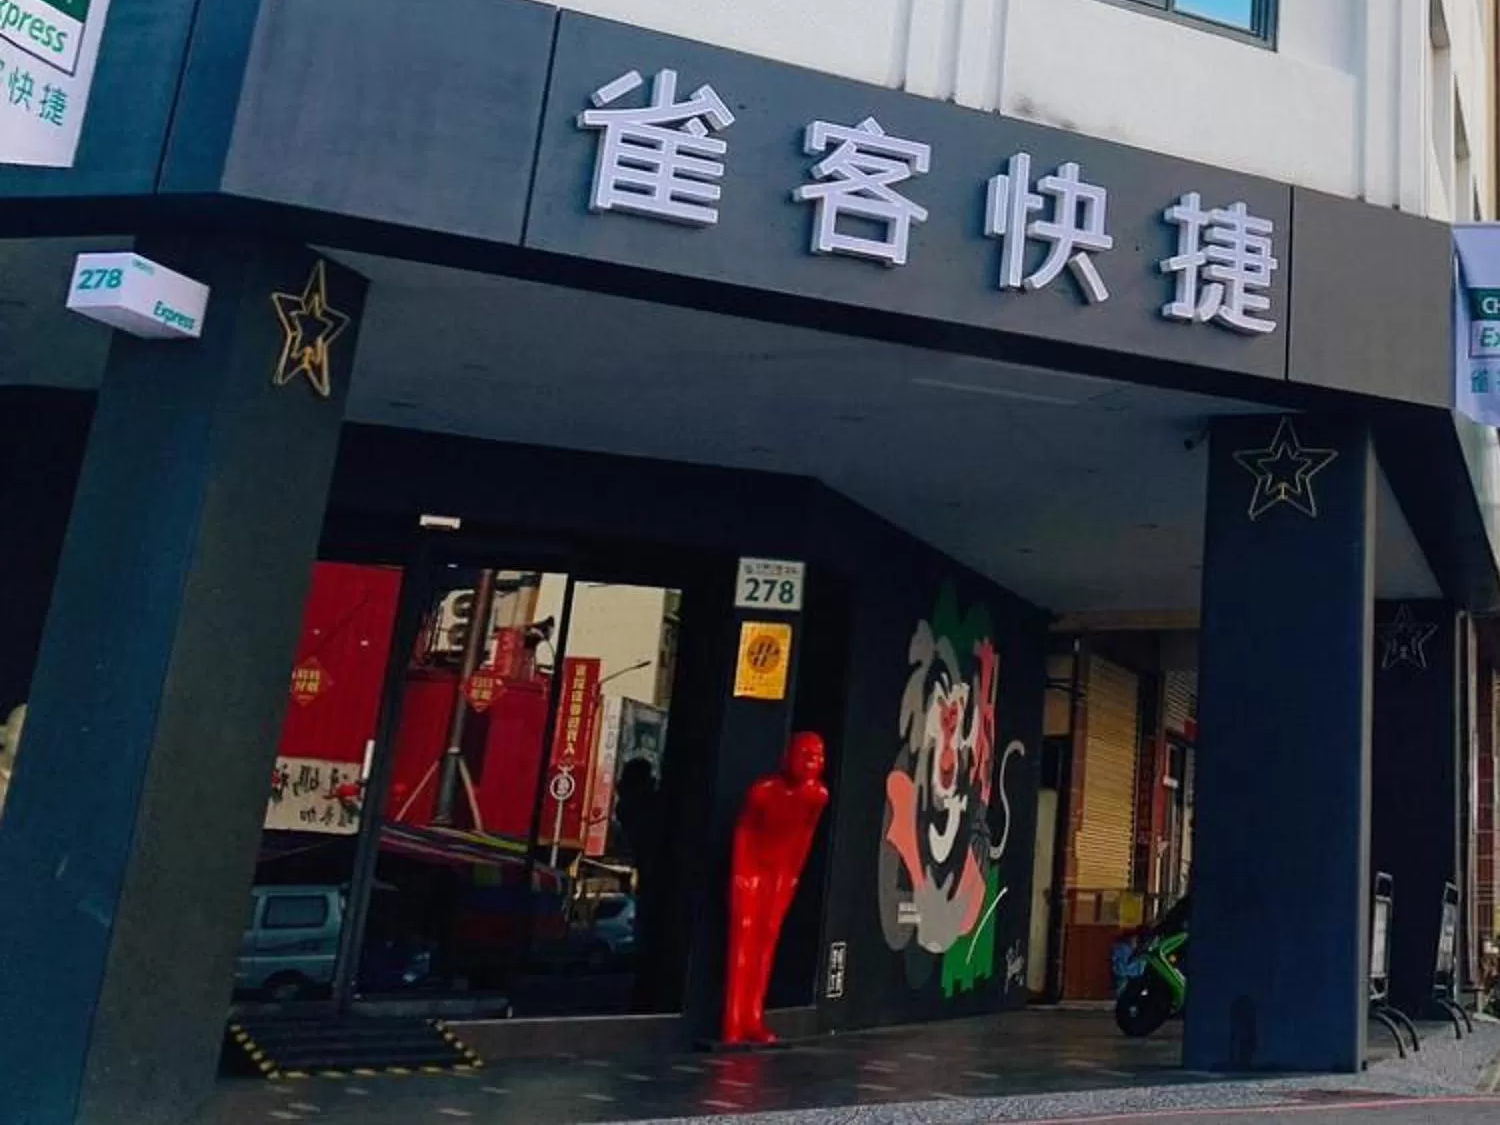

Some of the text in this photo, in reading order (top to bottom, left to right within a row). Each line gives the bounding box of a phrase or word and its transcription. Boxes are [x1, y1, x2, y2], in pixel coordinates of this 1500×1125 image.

[0, 58, 69, 126] 快捷
[577, 68, 1279, 333] 雀客快捷
[78, 268, 123, 290] 278
[153, 300, 195, 330] Express
[745, 579, 795, 604] 278
